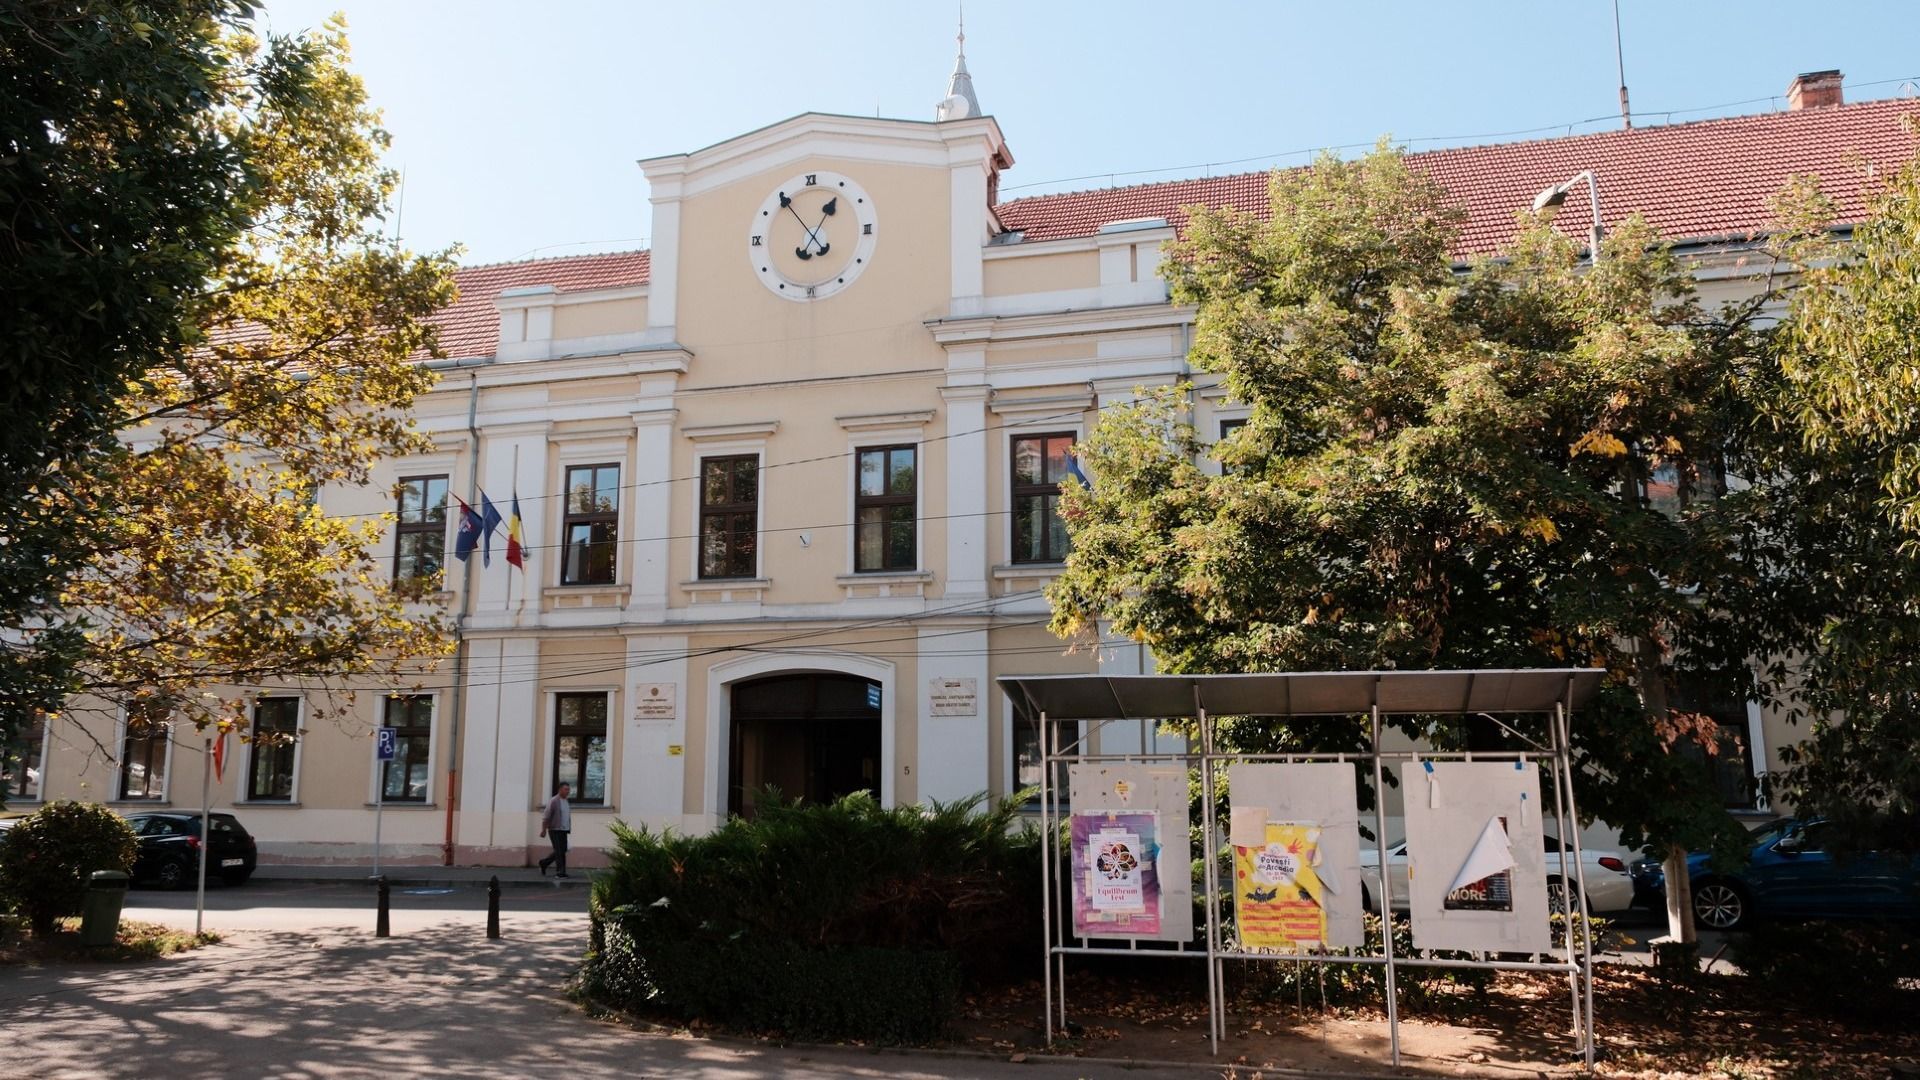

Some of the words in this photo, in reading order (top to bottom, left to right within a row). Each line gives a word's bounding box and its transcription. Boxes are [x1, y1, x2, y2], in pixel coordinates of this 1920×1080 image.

[751, 236, 762, 246] IX
[379, 731, 390, 748] P
[904, 766, 911, 776] 5
[1265, 863, 1294, 873] Arcadia
[1447, 889, 1487, 901] MORE
